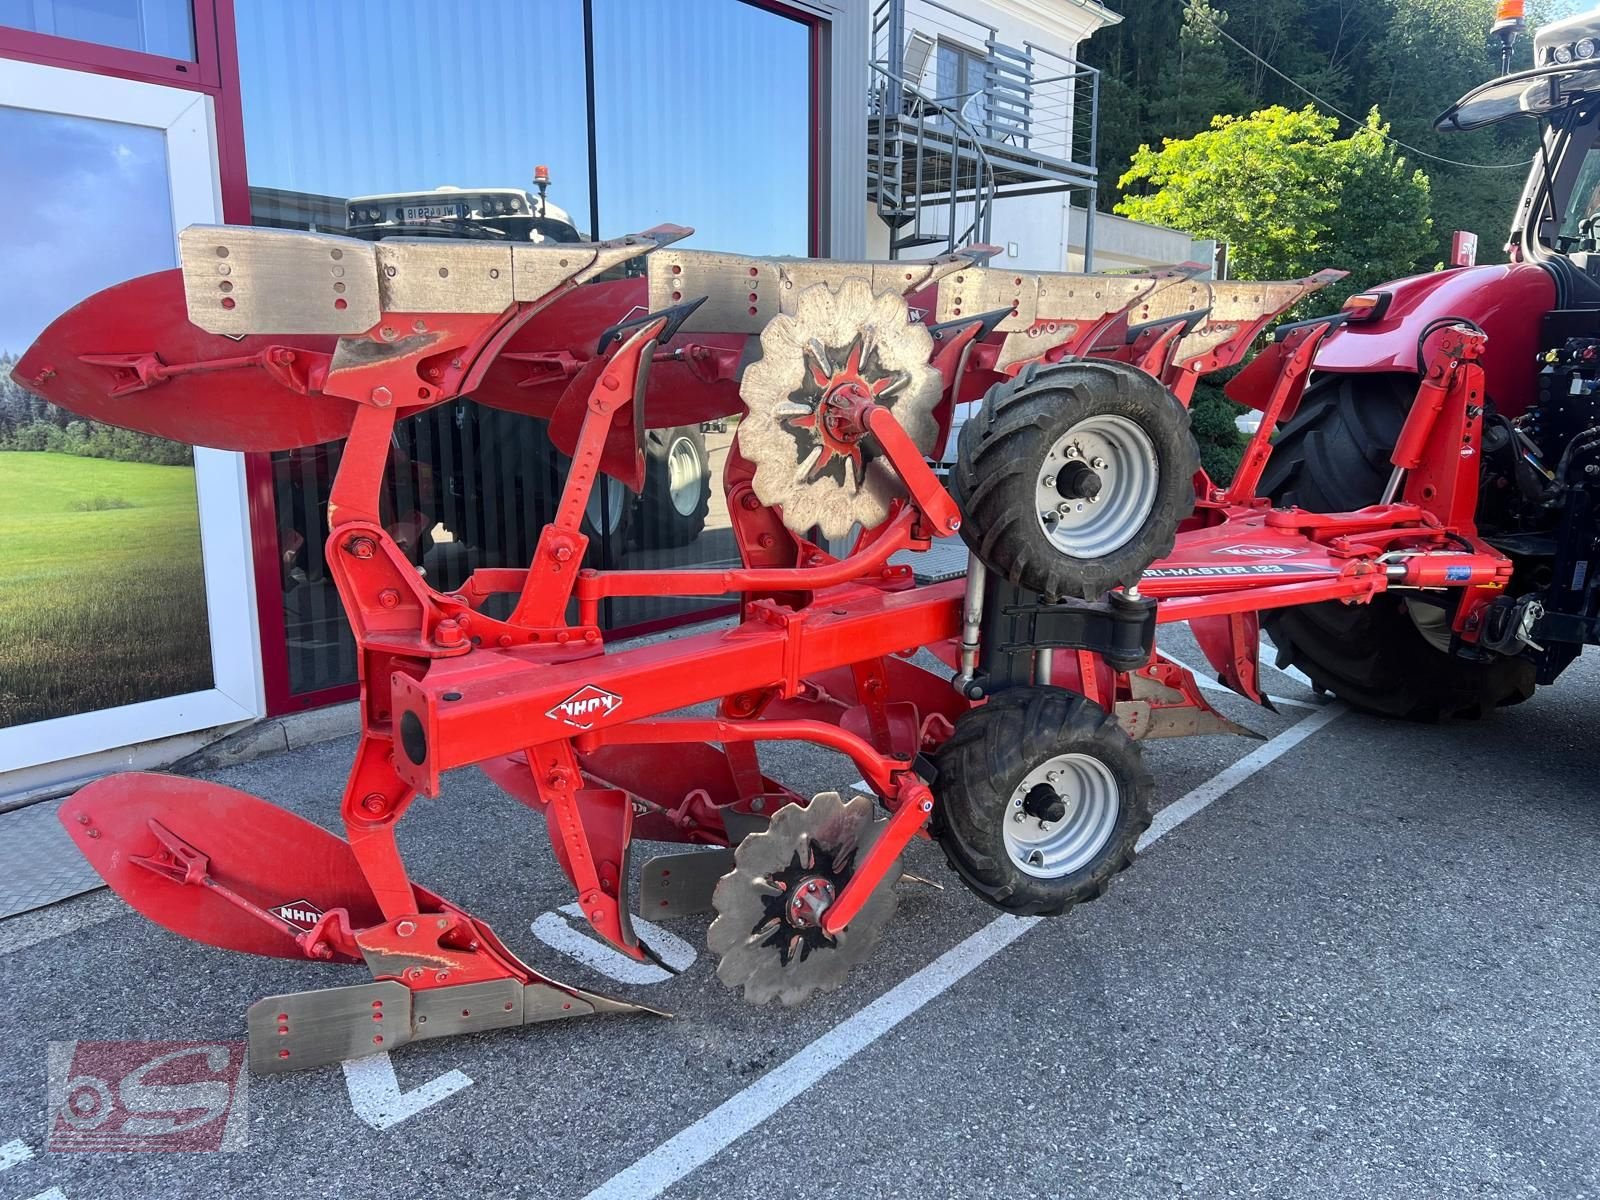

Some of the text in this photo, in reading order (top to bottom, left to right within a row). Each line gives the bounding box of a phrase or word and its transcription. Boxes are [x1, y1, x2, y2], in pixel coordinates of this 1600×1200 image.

[1142, 565, 1284, 577] RI-MASTER 123
[560, 695, 613, 716] KUHN
[280, 907, 322, 924] UHN
